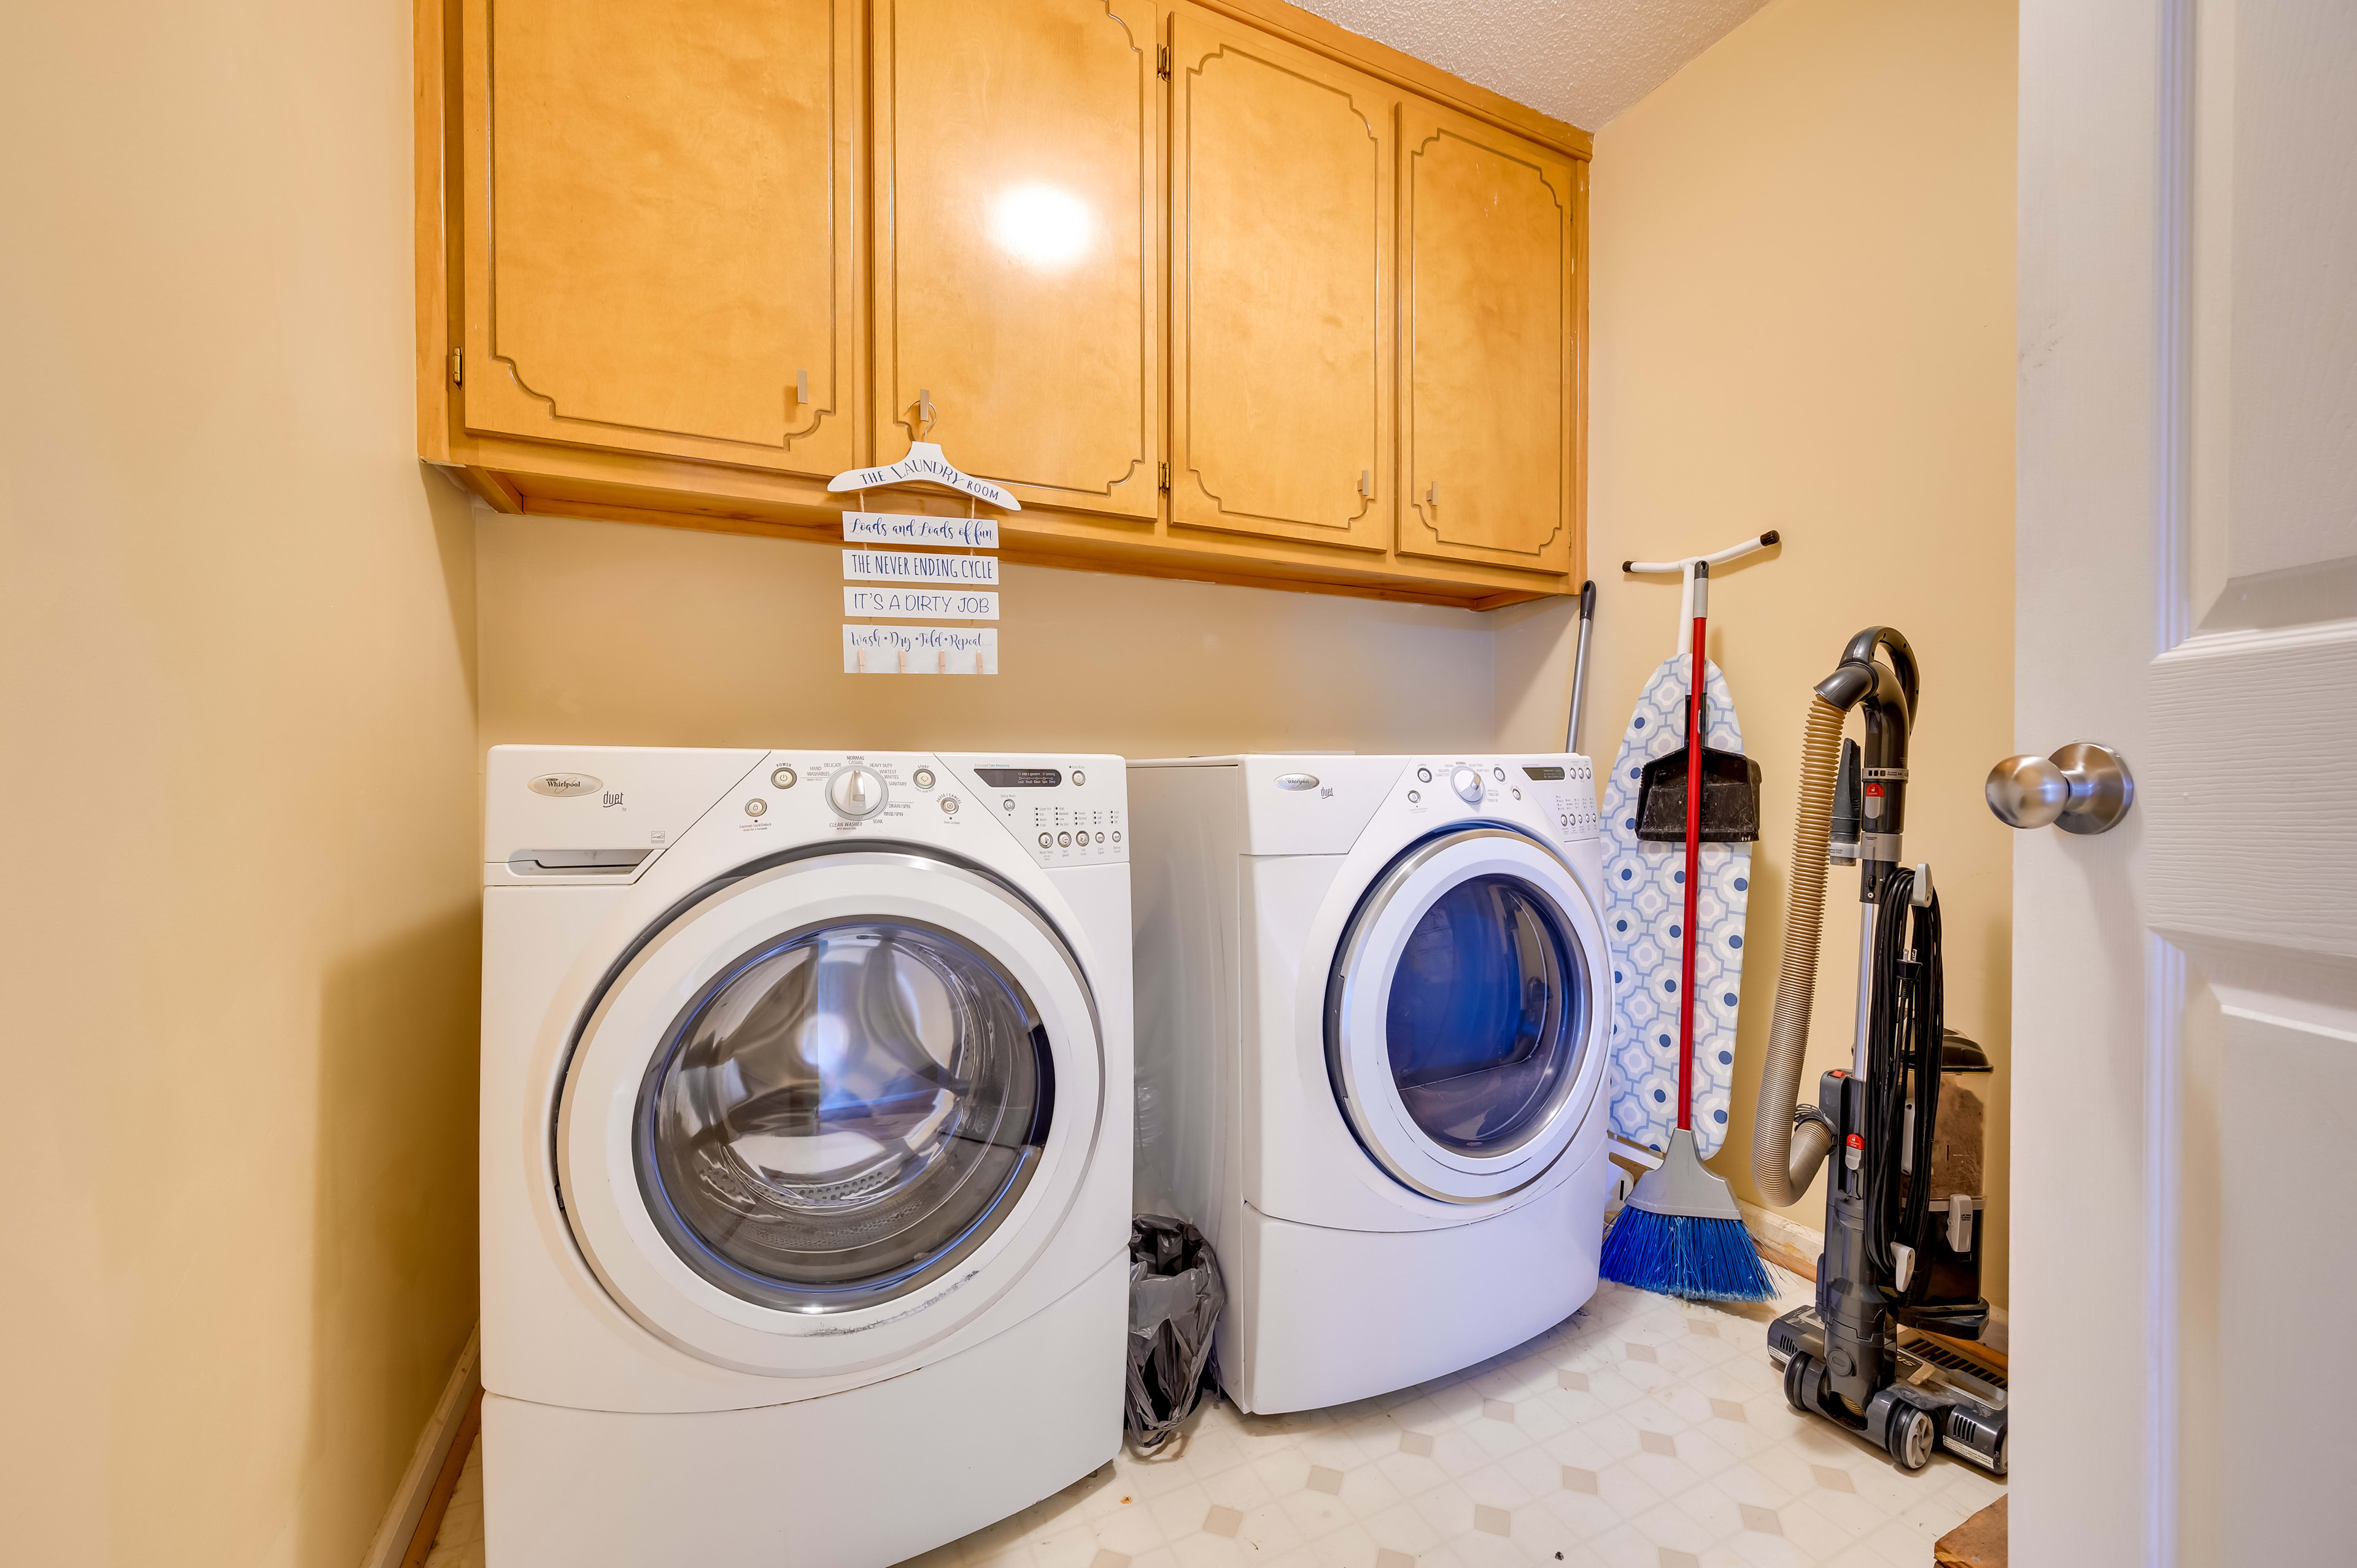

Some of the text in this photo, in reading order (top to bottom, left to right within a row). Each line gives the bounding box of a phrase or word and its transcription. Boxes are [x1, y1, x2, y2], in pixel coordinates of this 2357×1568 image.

[859, 460, 999, 501] THE LAUNDRY ROOM
[850, 517, 993, 546] Loads and Loads of fun
[851, 555, 993, 579] THE NEVER ENDING CYCLE
[854, 593, 989, 613] IT'S A DIRTY JOB
[851, 629, 881, 647] Wash
[889, 631, 911, 652] Dry
[603, 791, 624, 805] duet
[1321, 786, 1333, 797] duet
